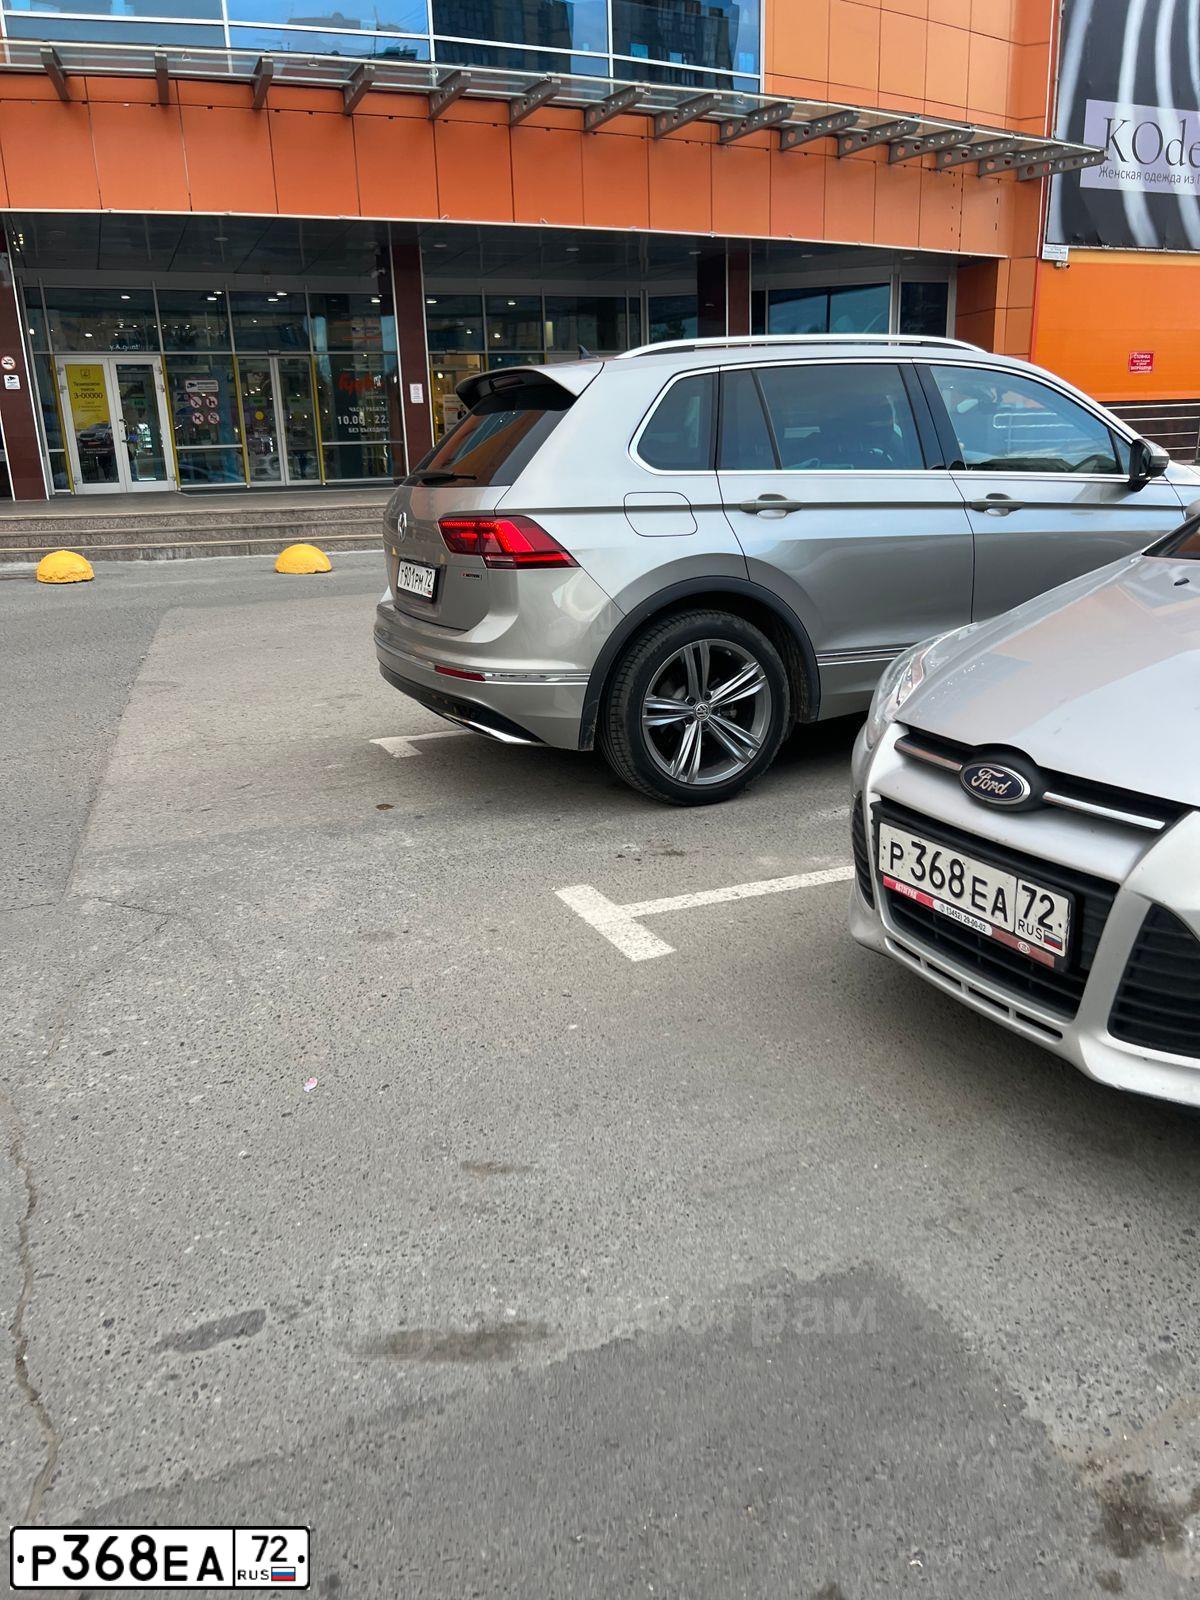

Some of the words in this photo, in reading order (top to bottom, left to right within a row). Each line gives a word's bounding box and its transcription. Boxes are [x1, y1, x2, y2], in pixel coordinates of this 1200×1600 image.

[1098, 166, 1142, 180] Женская
[1144, 171, 1181, 184] одежда
[1184, 175, 1195, 184] из
[374, 414, 390, 423] 22.
[971, 767, 1012, 796] Ford
[889, 841, 1009, 923] Р368ЕА
[1022, 884, 1055, 931] 72
[1018, 919, 1042, 940] RUS
